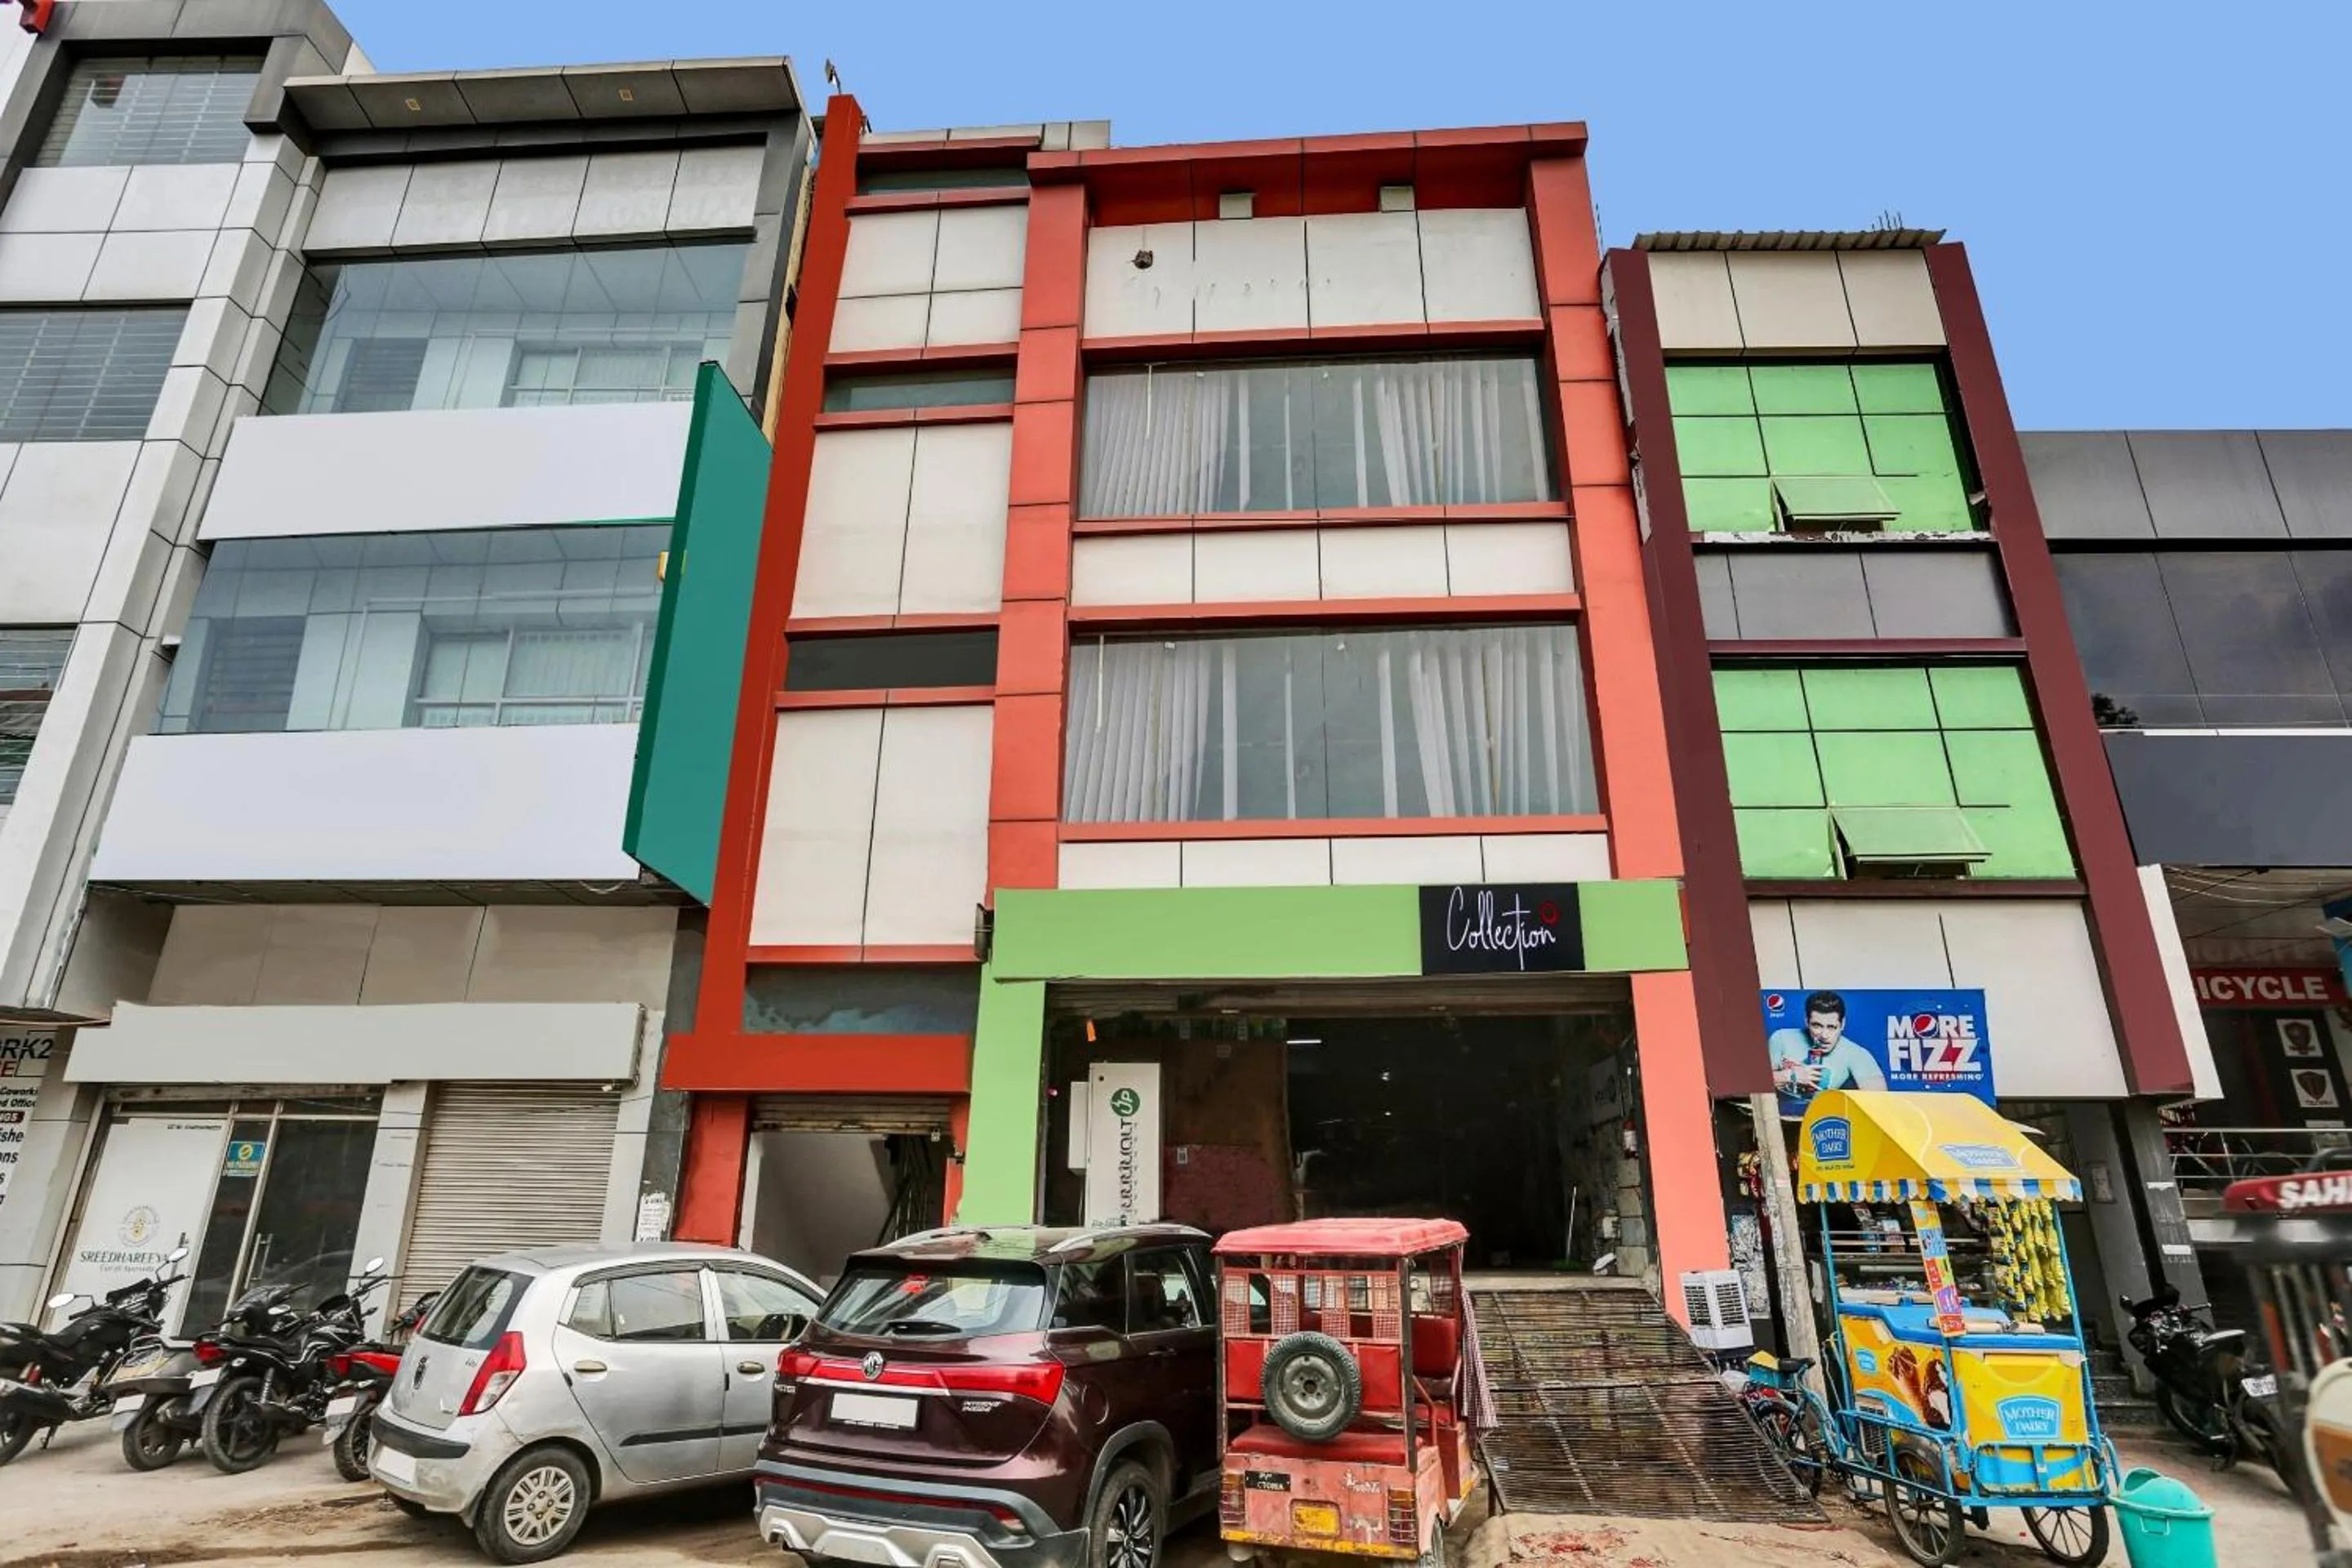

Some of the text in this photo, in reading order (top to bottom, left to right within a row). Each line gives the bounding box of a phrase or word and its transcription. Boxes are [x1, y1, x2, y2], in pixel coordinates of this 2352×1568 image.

[1446, 886, 1556, 970] Collection
[2197, 976, 2328, 1000] ICYCLE
[1887, 1013, 1976, 1039] MORE
[0, 1038, 54, 1058] RK2
[1887, 1039, 1981, 1071] FIZZ
[2005, 1406, 2056, 1420] MOTHER
